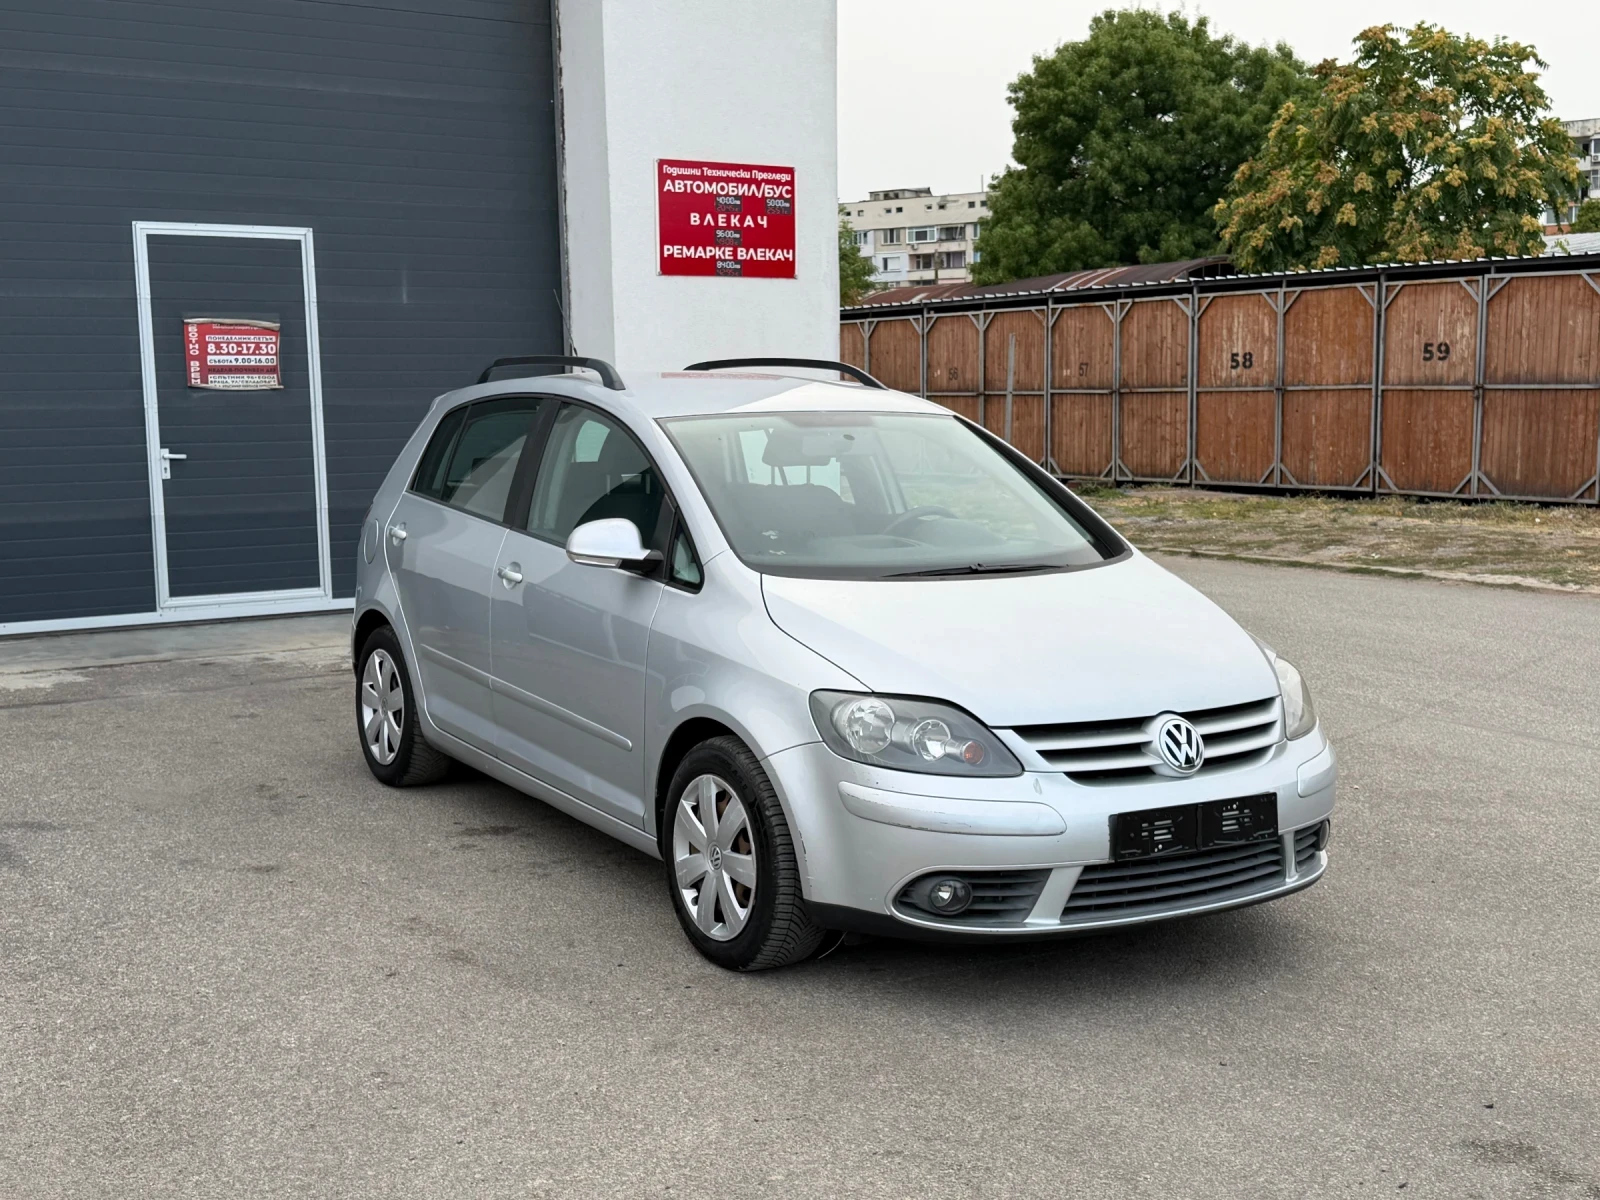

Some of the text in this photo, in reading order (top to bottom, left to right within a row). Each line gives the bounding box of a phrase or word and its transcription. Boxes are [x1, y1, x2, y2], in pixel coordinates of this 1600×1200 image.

[663, 165, 791, 182] Годишни Технически Прегледи
[663, 179, 792, 198] АВТОМОБИЛ/БУС
[690, 213, 768, 228] ВЛЕКАЧ
[663, 245, 793, 261] РЕМАРКЕ ВЛЕКАЧ
[207, 343, 276, 354] 8.30-17.30
[1422, 342, 1451, 361] 59
[1230, 351, 1254, 370] 58
[1159, 718, 1203, 772] VW
